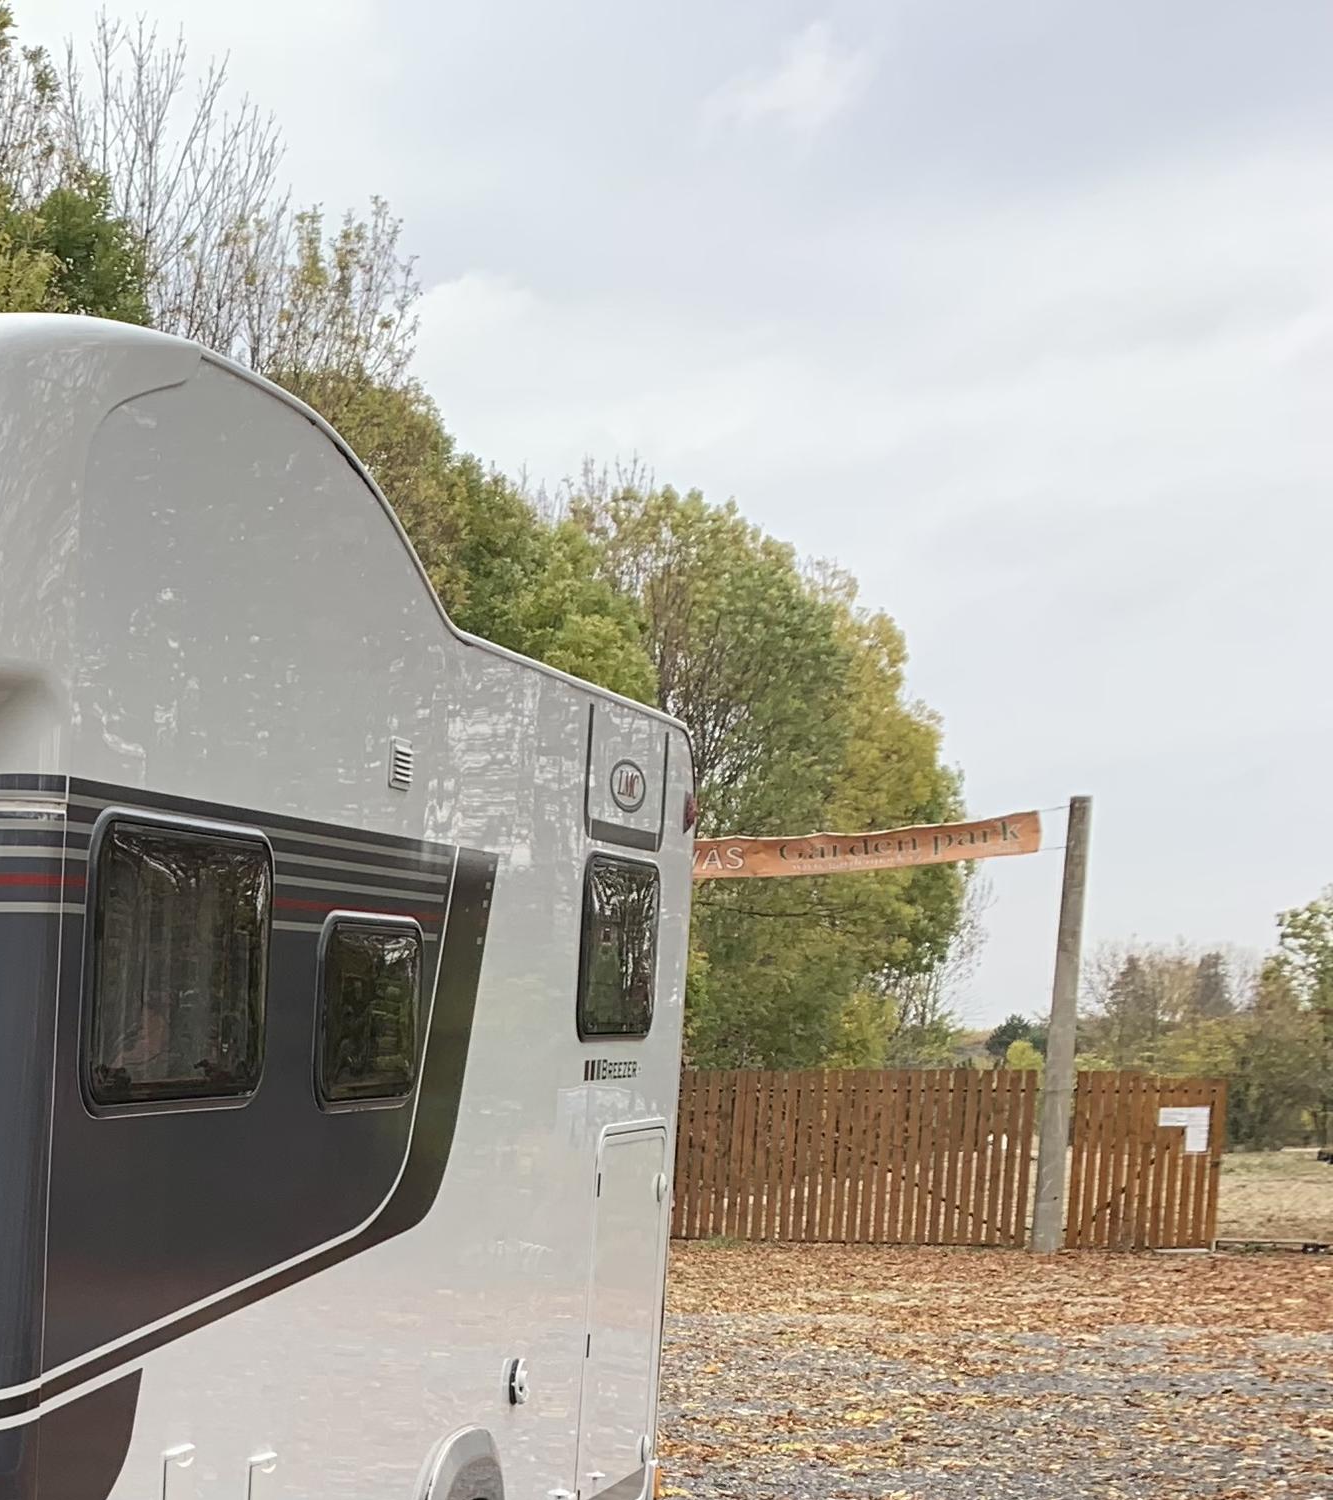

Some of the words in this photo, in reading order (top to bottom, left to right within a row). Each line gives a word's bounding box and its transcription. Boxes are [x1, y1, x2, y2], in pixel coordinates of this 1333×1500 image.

[617, 769, 640, 800] LMC
[779, 835, 920, 862] Garden
[933, 821, 1021, 856] park
